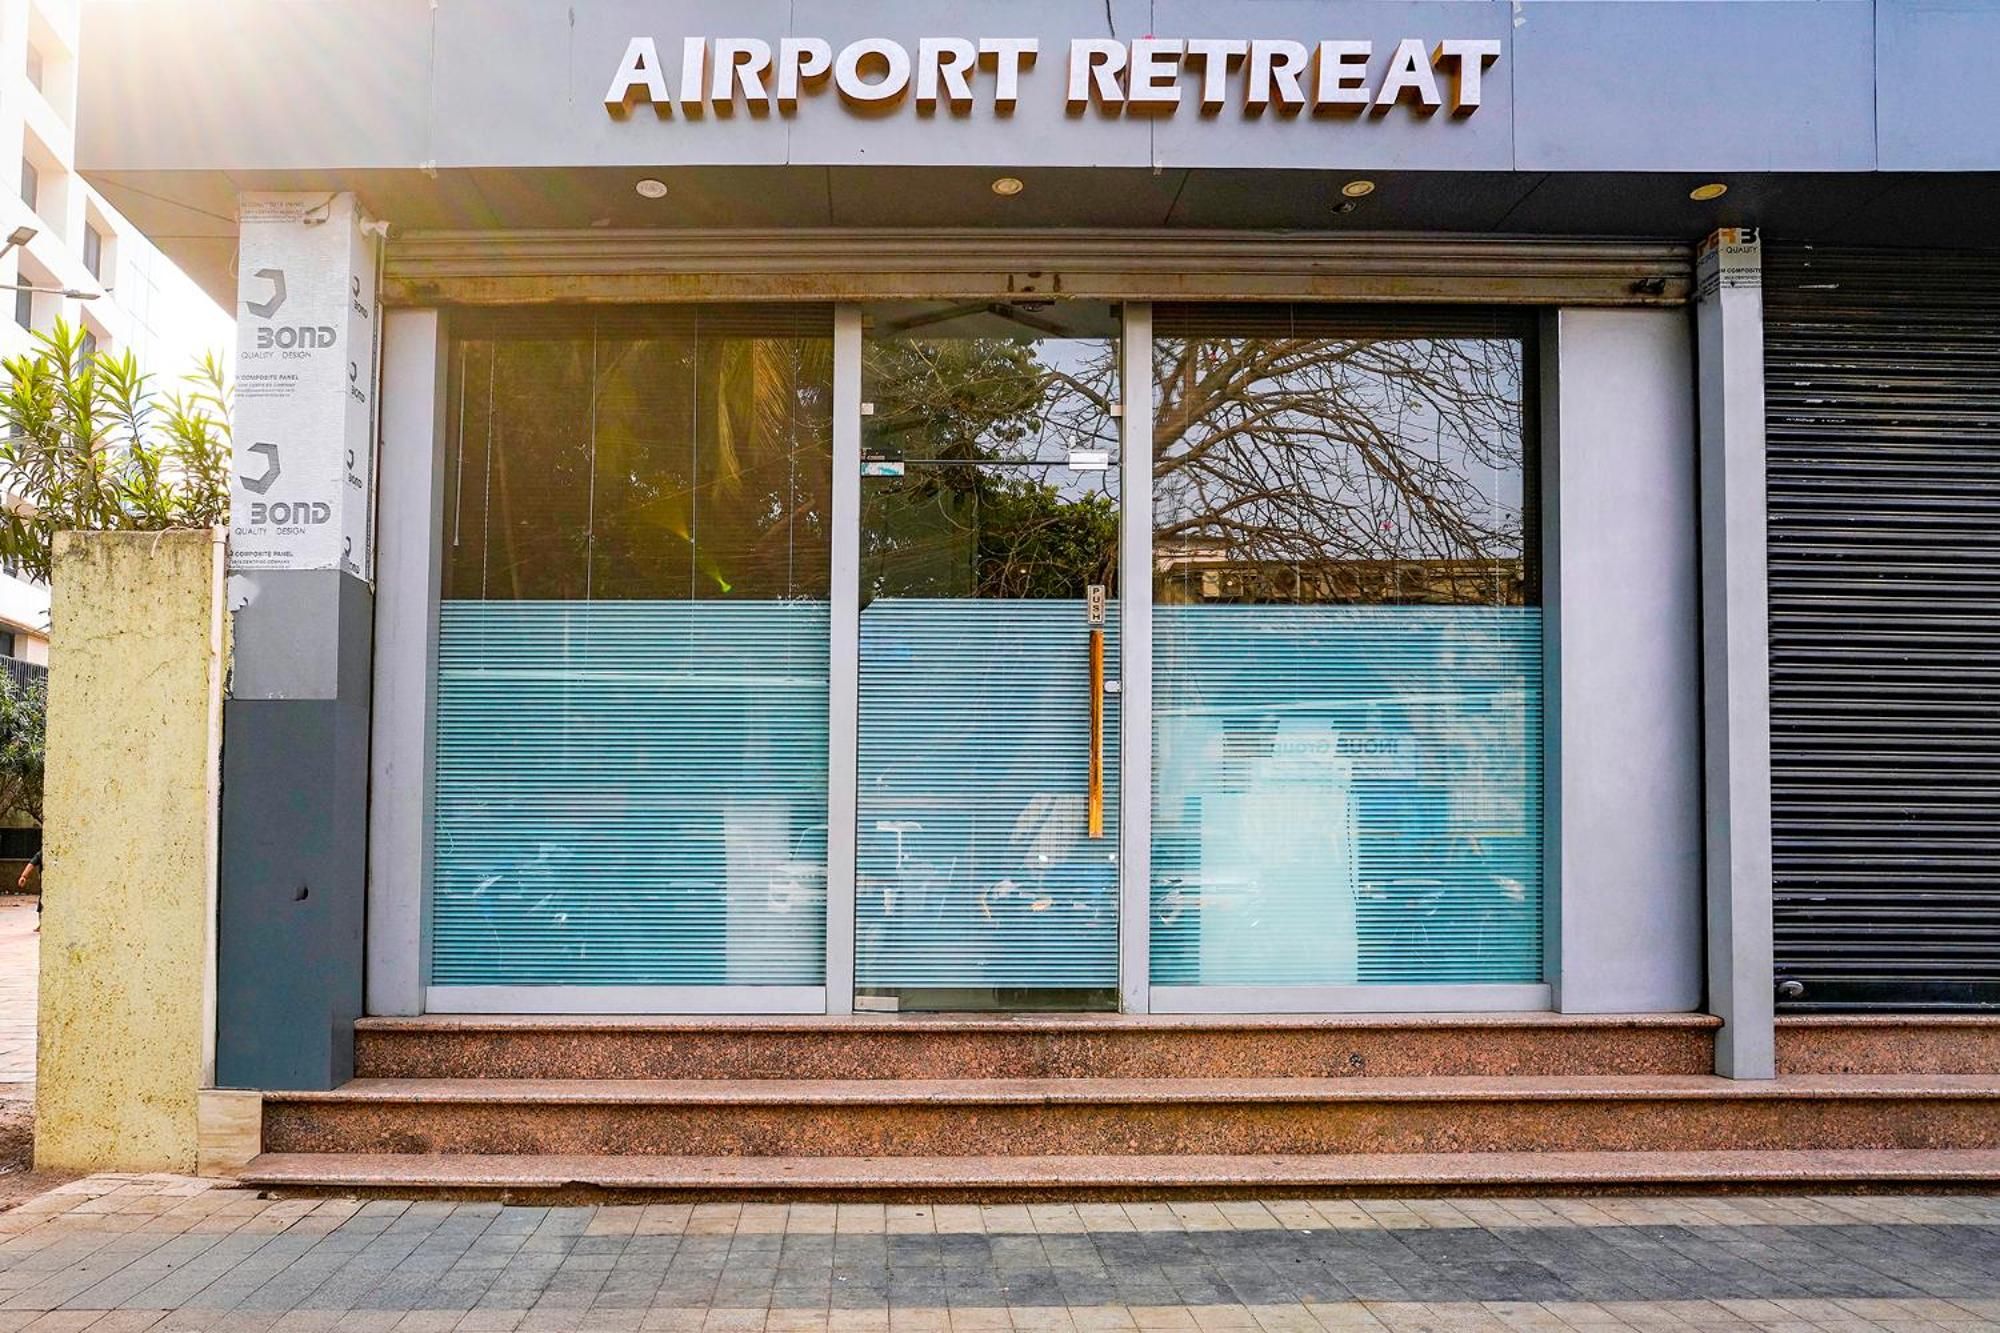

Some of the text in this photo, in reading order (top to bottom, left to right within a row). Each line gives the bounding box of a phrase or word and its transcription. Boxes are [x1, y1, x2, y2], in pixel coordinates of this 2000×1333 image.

[604, 37, 1501, 114] AIRPORT RETREAT
[257, 326, 337, 349] BOND
[241, 352, 274, 360] QUALITY
[251, 502, 331, 525] BOND
[234, 527, 267, 536] QUALITY
[1092, 587, 1101, 620] PUSH
